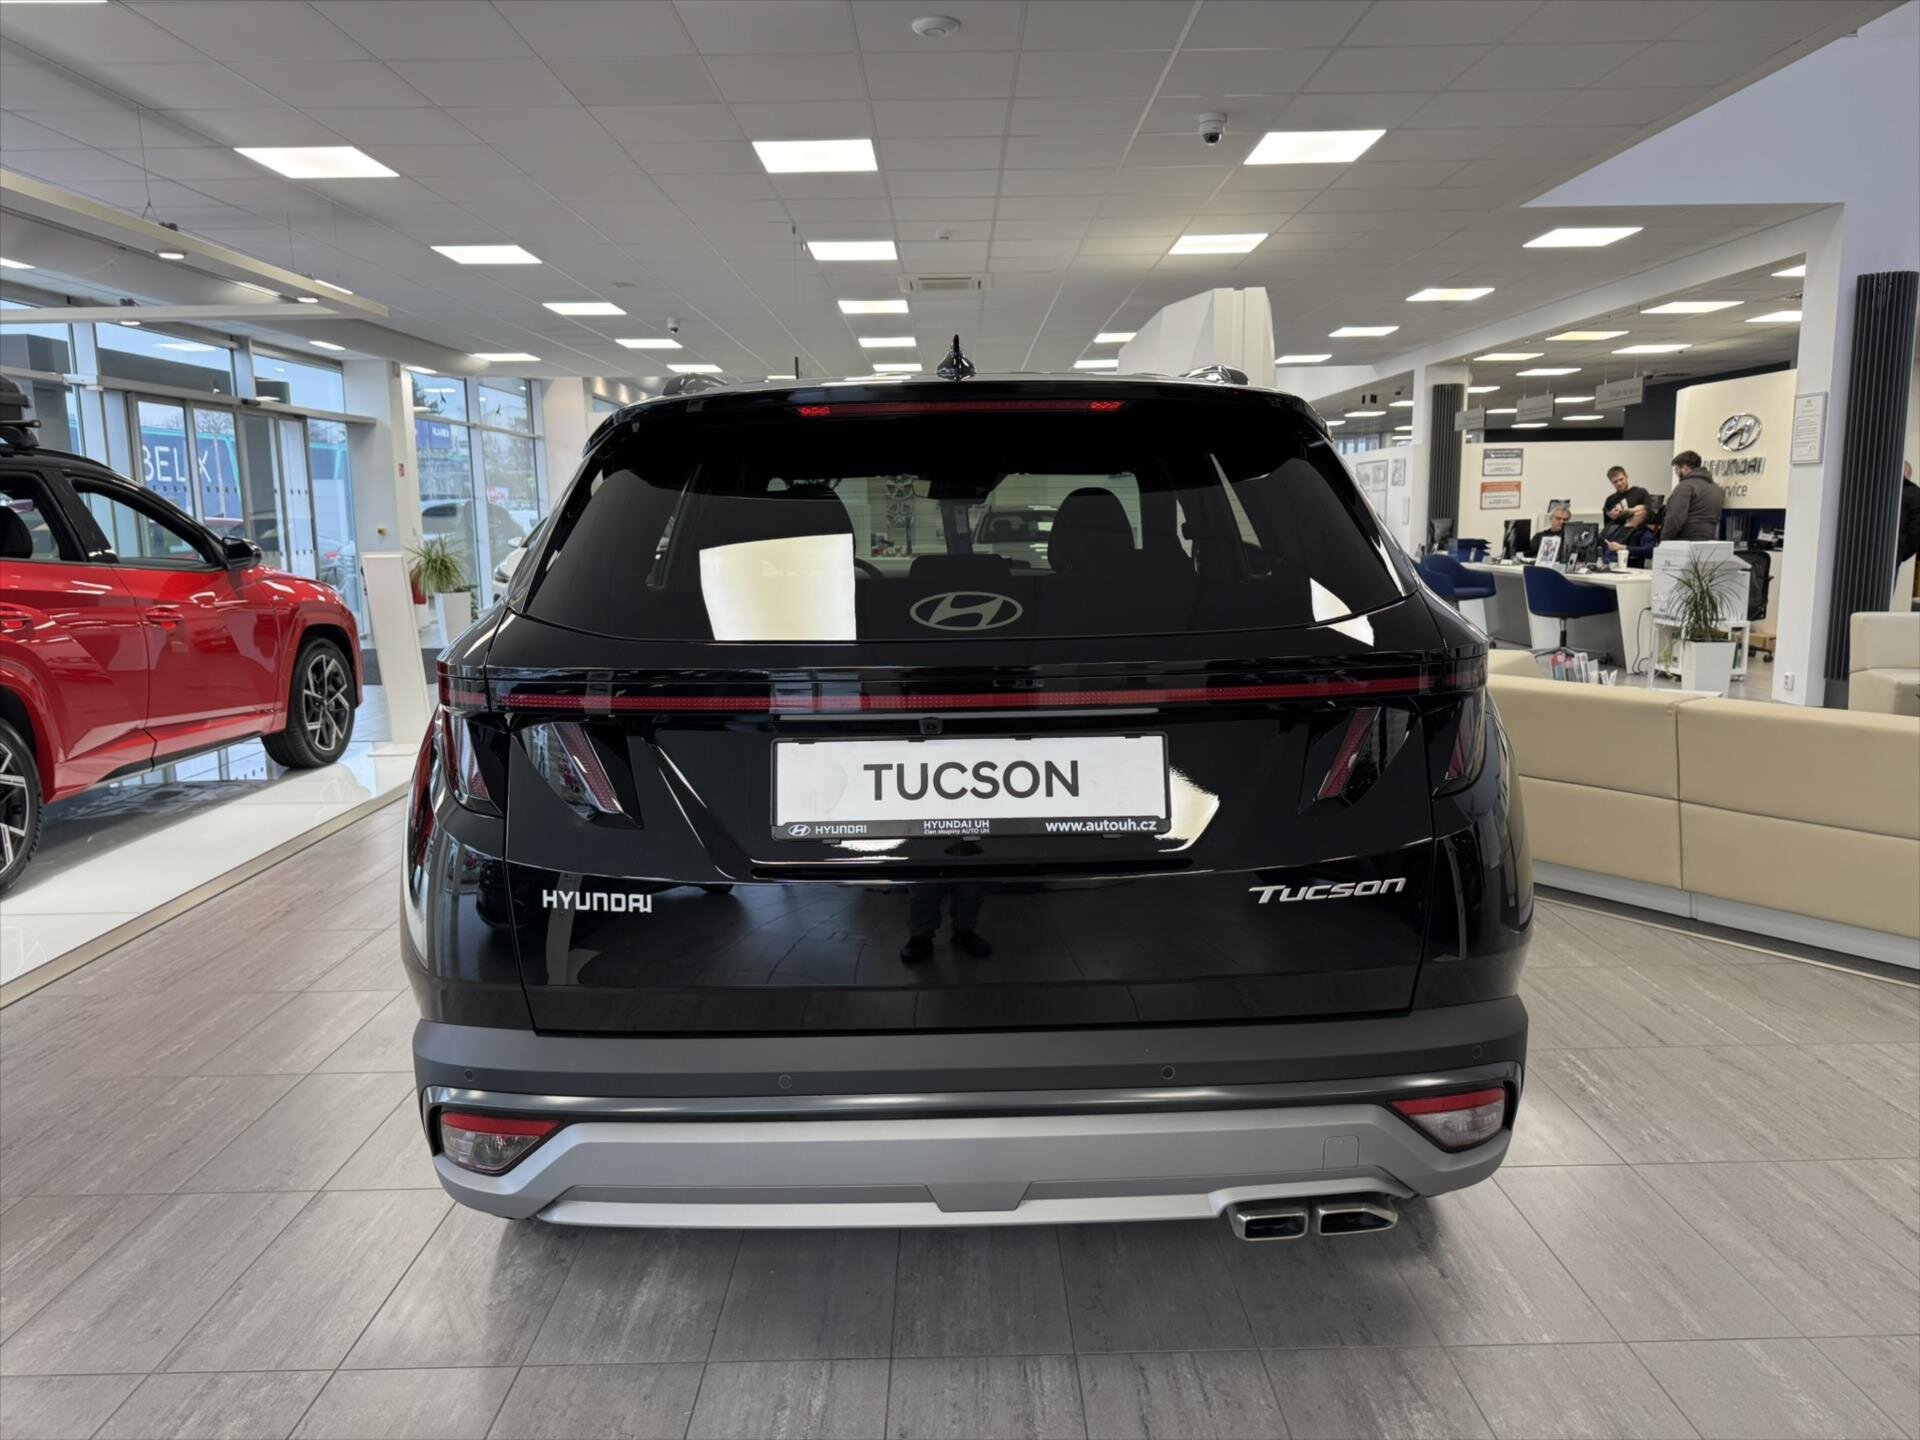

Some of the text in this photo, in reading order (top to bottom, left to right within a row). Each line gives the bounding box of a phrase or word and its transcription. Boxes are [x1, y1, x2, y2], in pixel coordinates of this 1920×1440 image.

[142, 445, 211, 483] BELX
[1723, 482, 1748, 497] rvice
[863, 760, 1080, 801] TUCSON
[815, 824, 867, 835] HYUNDAI
[924, 819, 990, 829] HYUNDAI UH
[1045, 818, 1157, 832] www.autouh.cz
[542, 889, 652, 913] HYUNDAI
